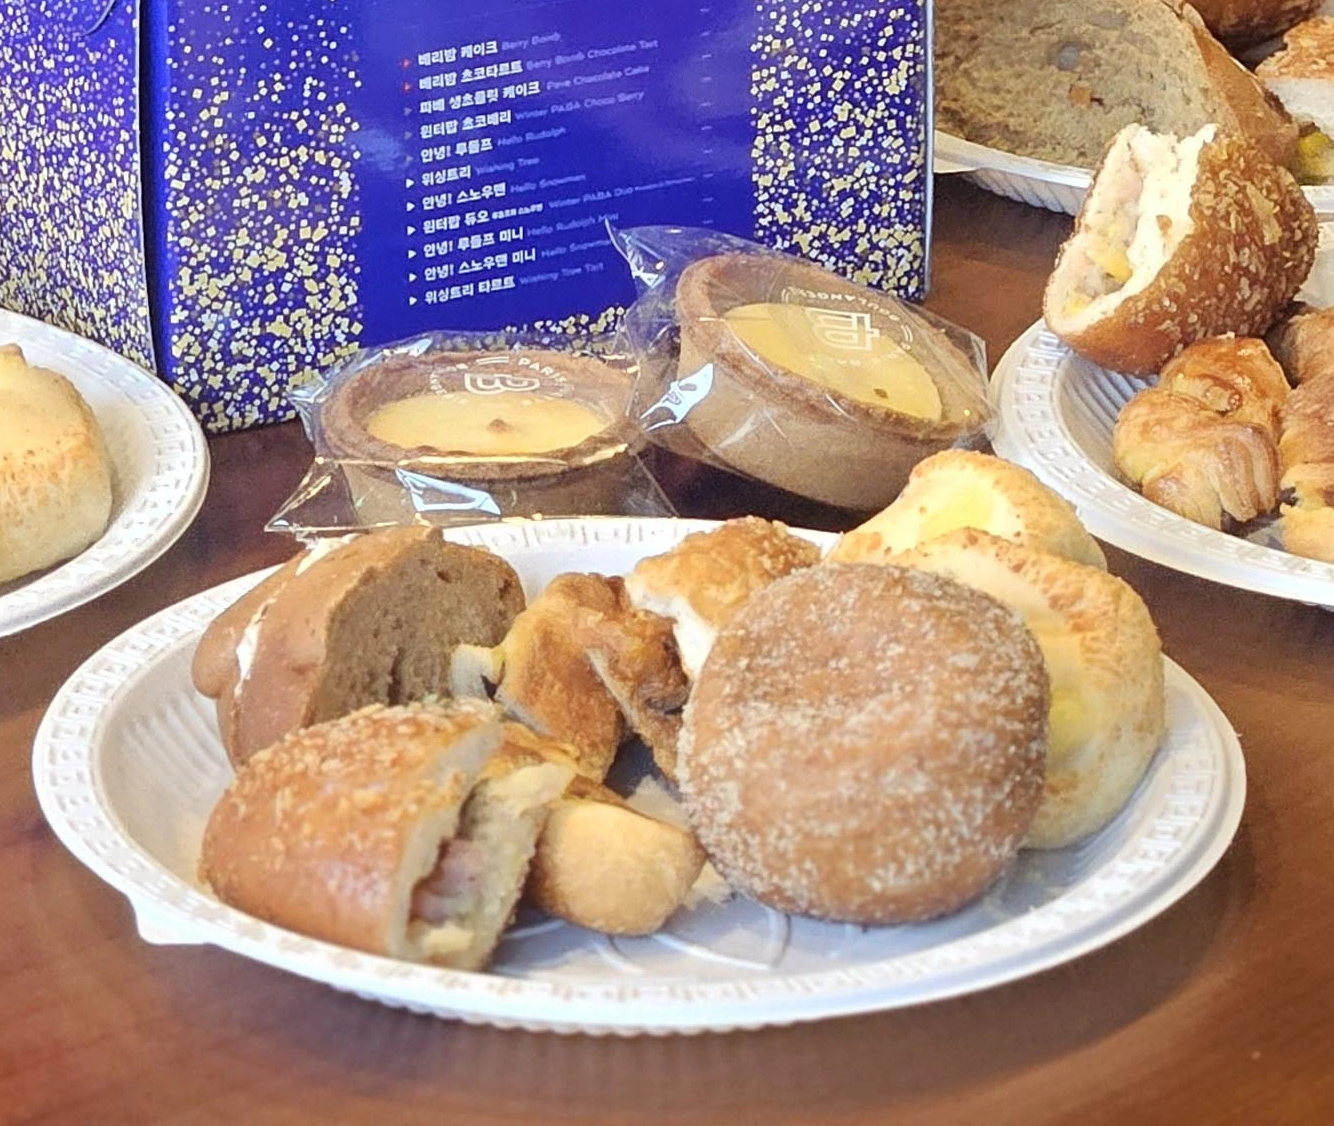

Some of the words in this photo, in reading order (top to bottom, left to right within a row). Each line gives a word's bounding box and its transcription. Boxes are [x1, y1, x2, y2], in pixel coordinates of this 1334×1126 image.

[460, 40, 499, 59] 케이크
[460, 60, 524, 83] 초코타르트
[502, 80, 542, 99] 케이크
[461, 109, 512, 132] 초코베리
[420, 145, 452, 164] 안녕!
[421, 164, 472, 187] 위싱트리
[422, 192, 453, 212] 안녕!
[456, 181, 507, 204] 스노우맨
[463, 209, 491, 226] 듀오
[423, 239, 454, 258] 안녕!
[499, 225, 524, 242] 미니
[424, 263, 455, 282] 안녕!
[458, 253, 508, 275] 스노우맨
[512, 247, 537, 264] 미니
[425, 282, 475, 305] 위싱트리
[478, 275, 517, 293] 타르트
